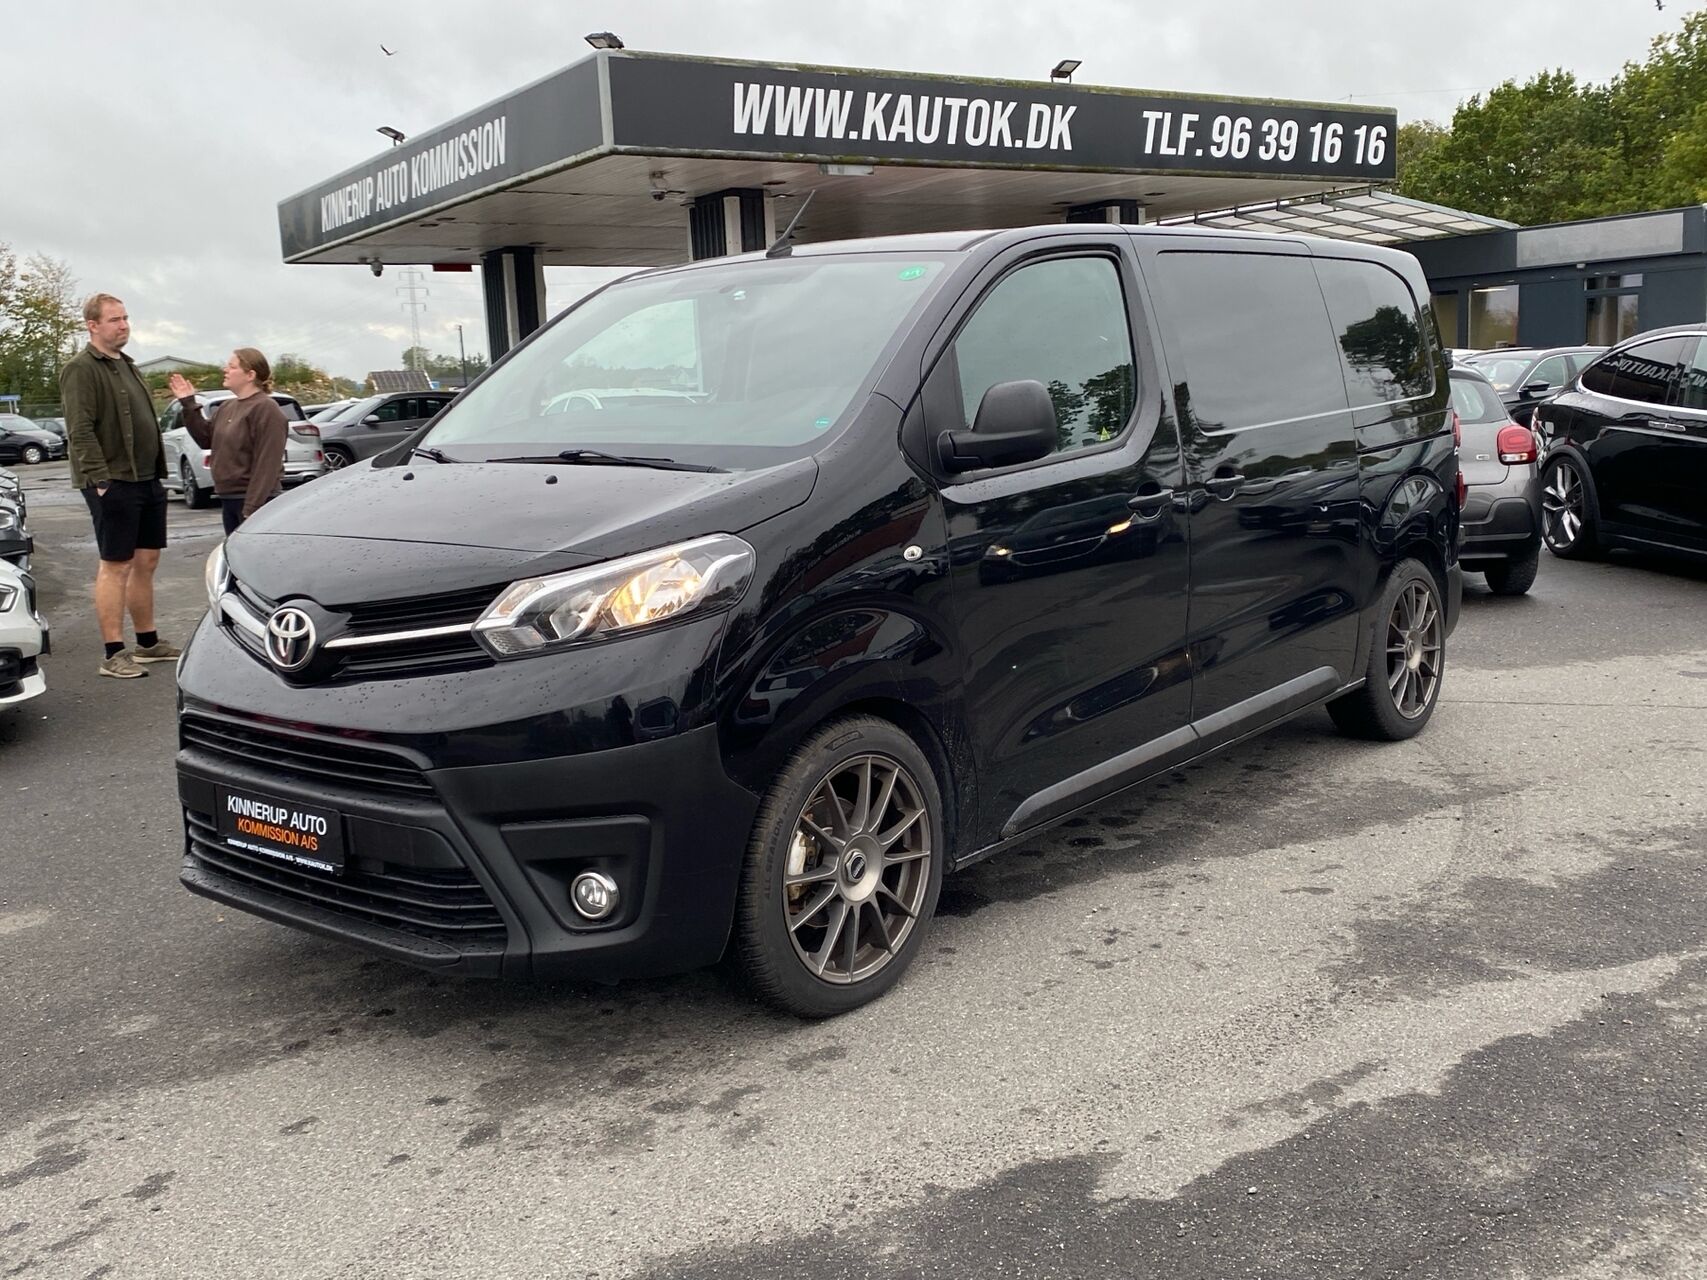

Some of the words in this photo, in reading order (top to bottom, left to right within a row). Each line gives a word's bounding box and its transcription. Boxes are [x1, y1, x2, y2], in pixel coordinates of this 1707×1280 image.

[733, 82, 1076, 151] WWW.KAUTOK.DK
[1143, 111, 1203, 157] TLF.
[1211, 115, 1252, 160] 96
[1258, 118, 1298, 162] 39
[1310, 122, 1343, 164] 16
[1354, 125, 1387, 165] 16
[321, 176, 373, 232] KINNERUP
[376, 160, 408, 212] AUTO
[411, 116, 506, 199] KOMMISSION
[227, 795, 287, 825] KINNERUP
[290, 811, 326, 835] AUTO
[238, 818, 298, 846] KOMMISSION
[300, 834, 318, 851] A/S
